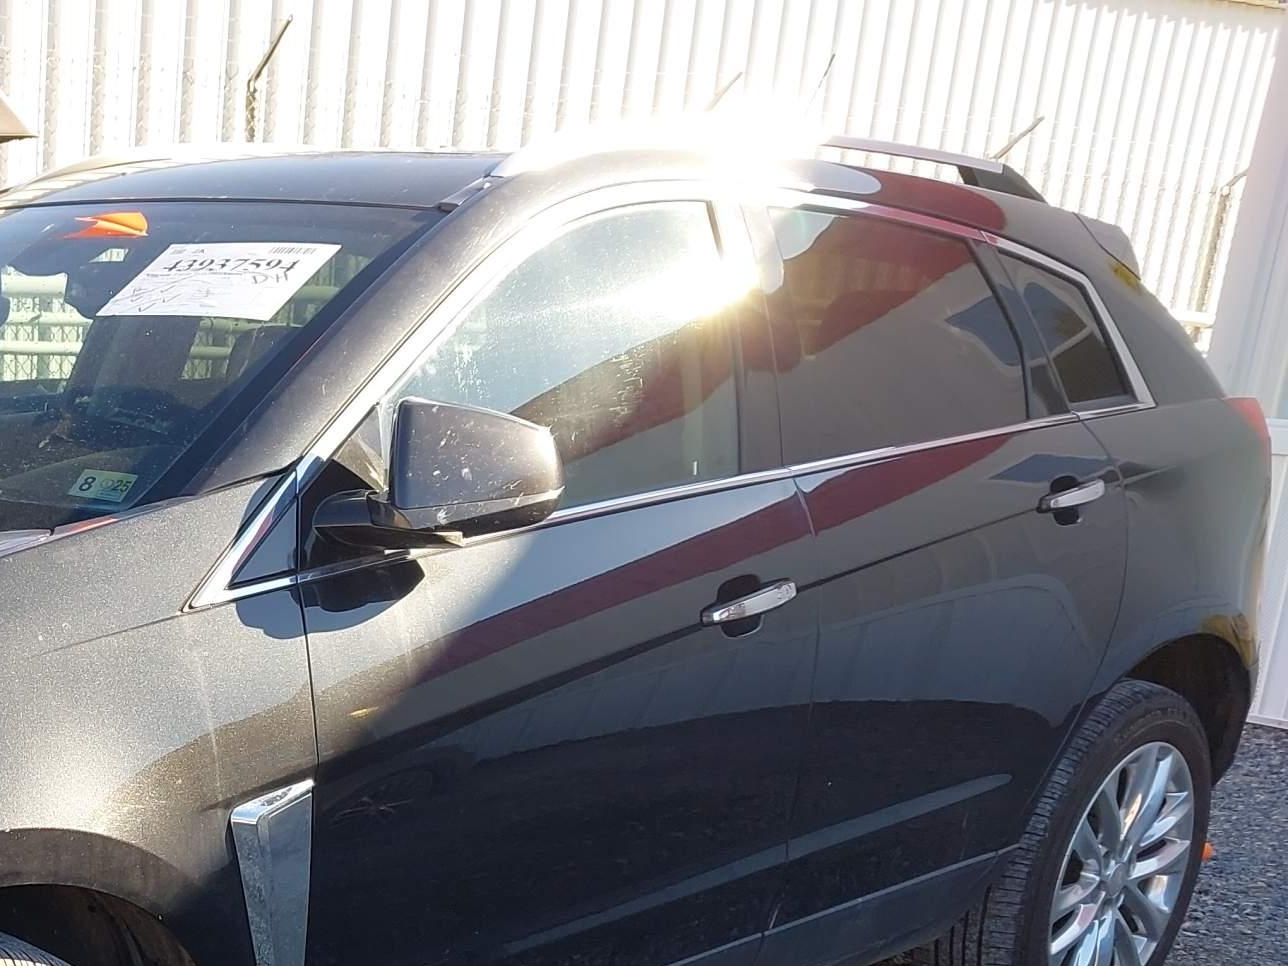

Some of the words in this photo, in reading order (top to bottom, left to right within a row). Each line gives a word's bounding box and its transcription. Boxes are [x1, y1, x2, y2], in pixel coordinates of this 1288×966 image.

[162, 258, 300, 272] 43937594
[79, 476, 97, 491] 8
[112, 480, 133, 493] 25
